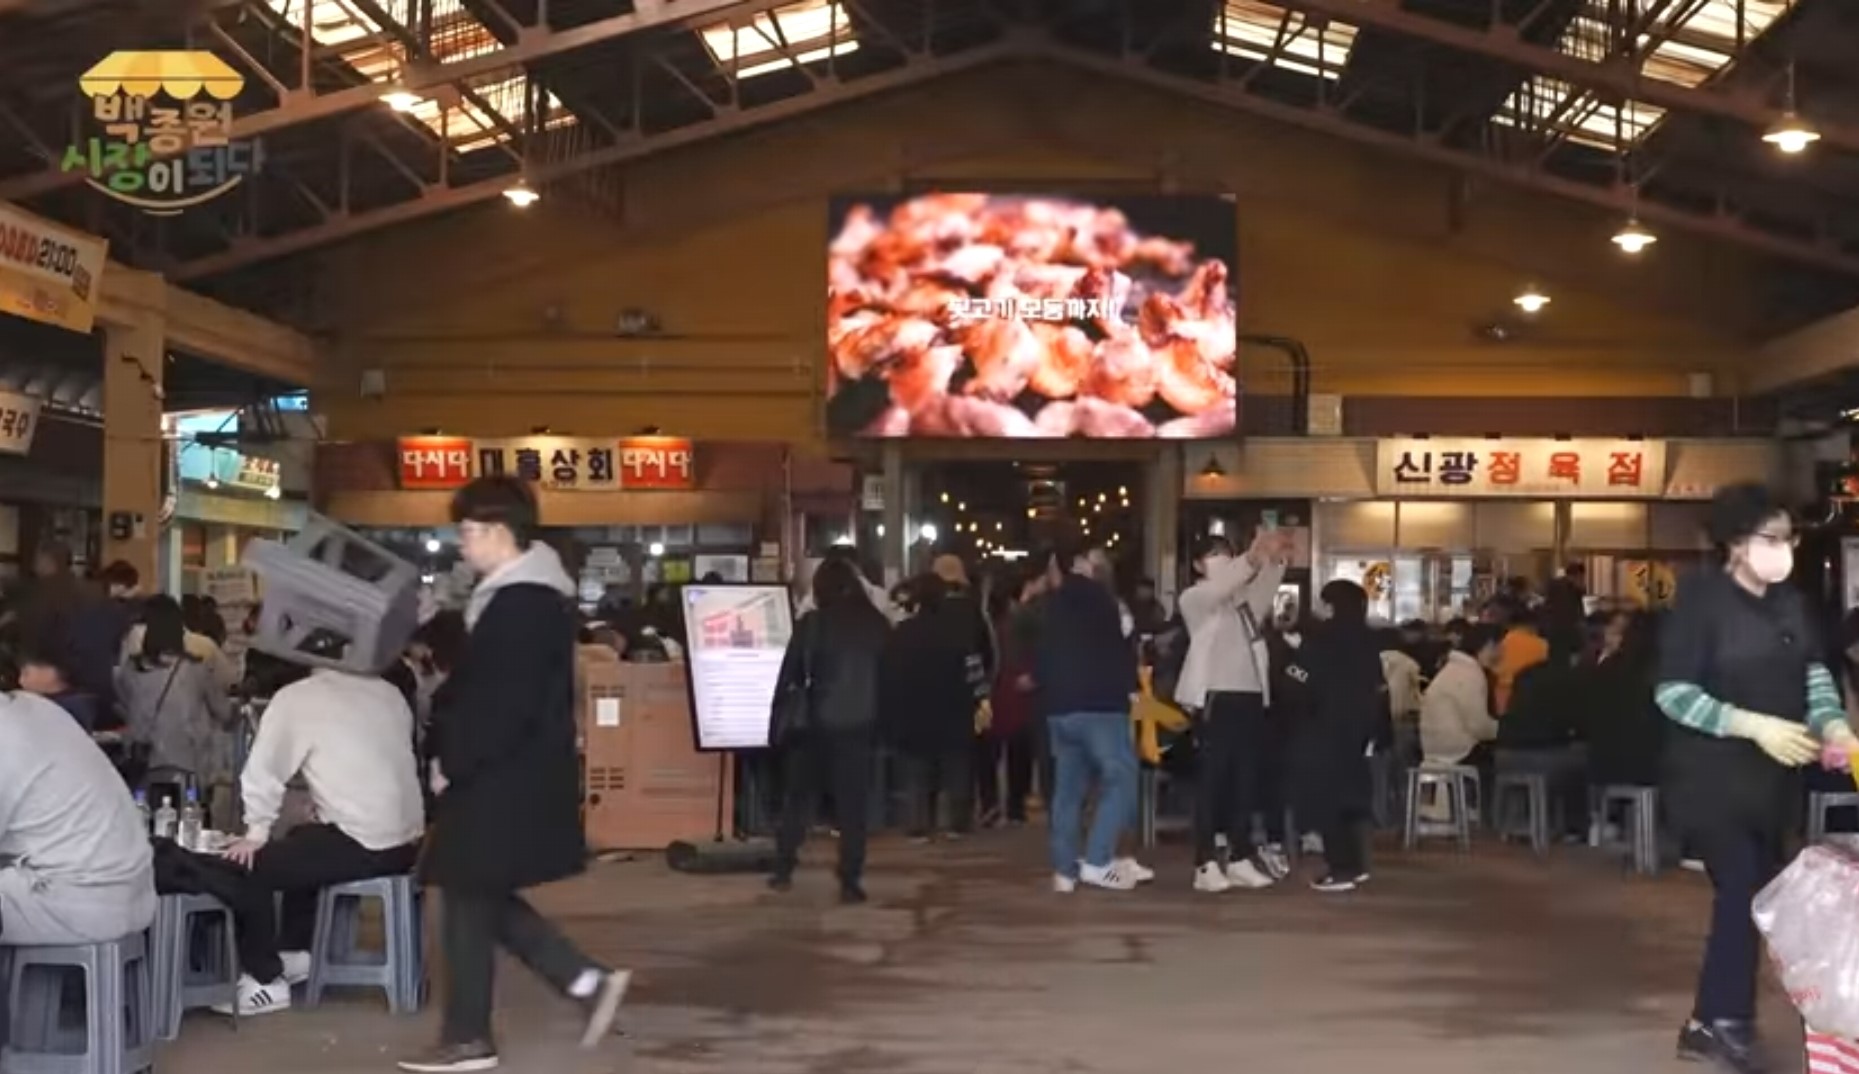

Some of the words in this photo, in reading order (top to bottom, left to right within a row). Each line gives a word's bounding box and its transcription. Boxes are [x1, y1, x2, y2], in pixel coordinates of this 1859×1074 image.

[0, 406, 30, 440] 국수
[402, 449, 469, 478] 다시다
[622, 448, 692, 478] 다시다
[1486, 451, 1643, 486] 정육점
